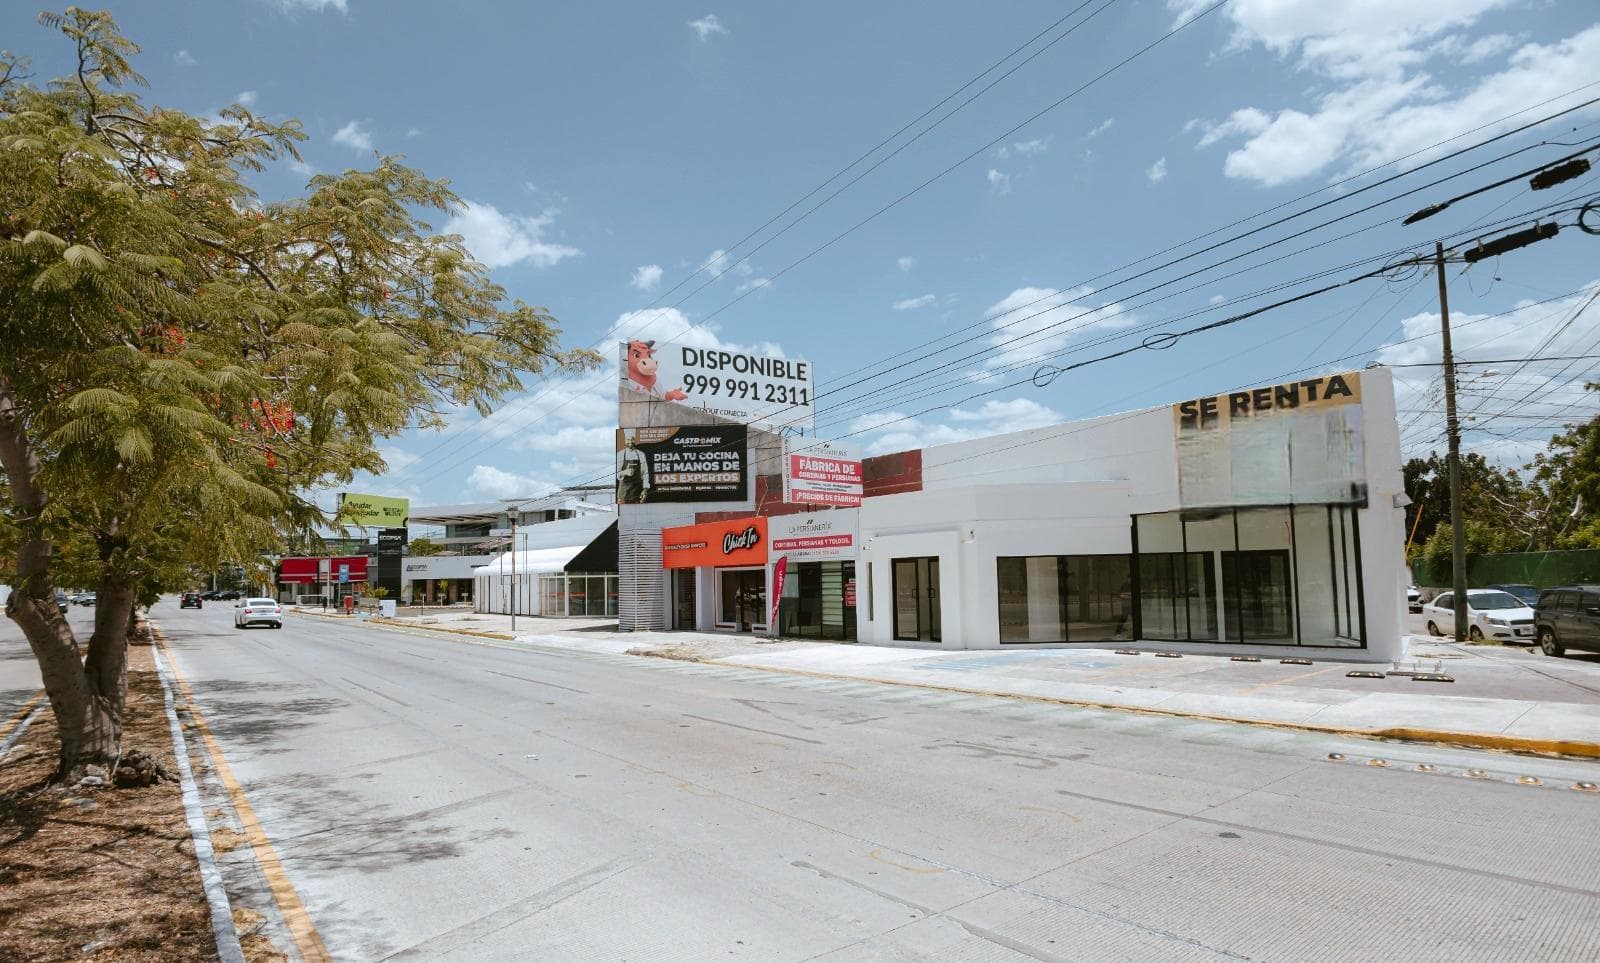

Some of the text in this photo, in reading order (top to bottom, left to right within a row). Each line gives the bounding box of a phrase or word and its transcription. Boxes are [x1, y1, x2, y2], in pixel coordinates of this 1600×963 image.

[682, 347, 807, 381] DISPONIBLE
[683, 374, 809, 406] 999 991 2311
[1180, 375, 1352, 418] SE RENTA
[654, 452, 739, 461] DEJA TU COCINA
[654, 461, 740, 472] EN MANOS DE
[800, 458, 855, 474] FÁBRICA DE
[655, 473, 738, 483] LOS EXPERTOS
